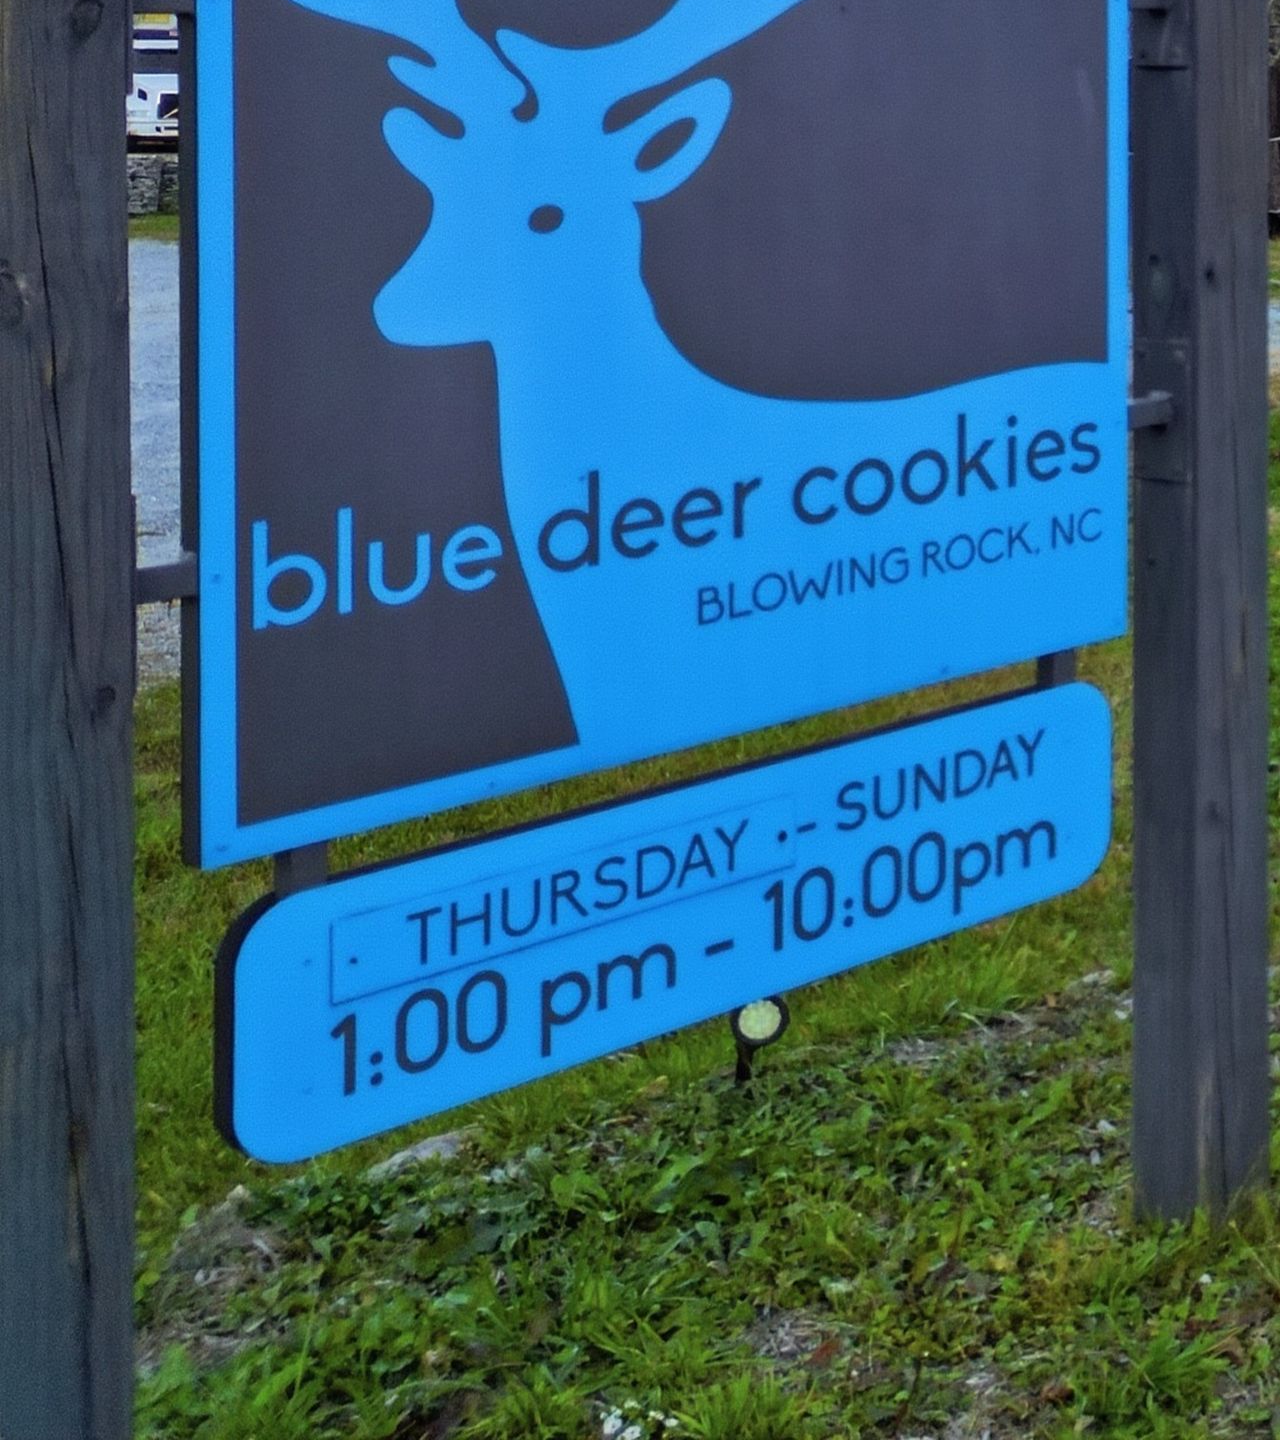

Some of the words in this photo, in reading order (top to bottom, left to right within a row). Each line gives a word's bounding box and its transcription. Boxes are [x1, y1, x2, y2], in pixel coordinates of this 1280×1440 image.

[250, 505, 505, 631] blue
[534, 468, 763, 574] deer
[790, 412, 1103, 527] cookies
[696, 545, 911, 627] BLOWING
[1050, 507, 1103, 550] NC
[329, 968, 509, 1097] 1:00
[539, 942, 678, 1059] pm
[762, 819, 1058, 953] 10:00pm
[407, 817, 750, 966] THURSDAY
[835, 729, 1045, 832] SUNDAY
